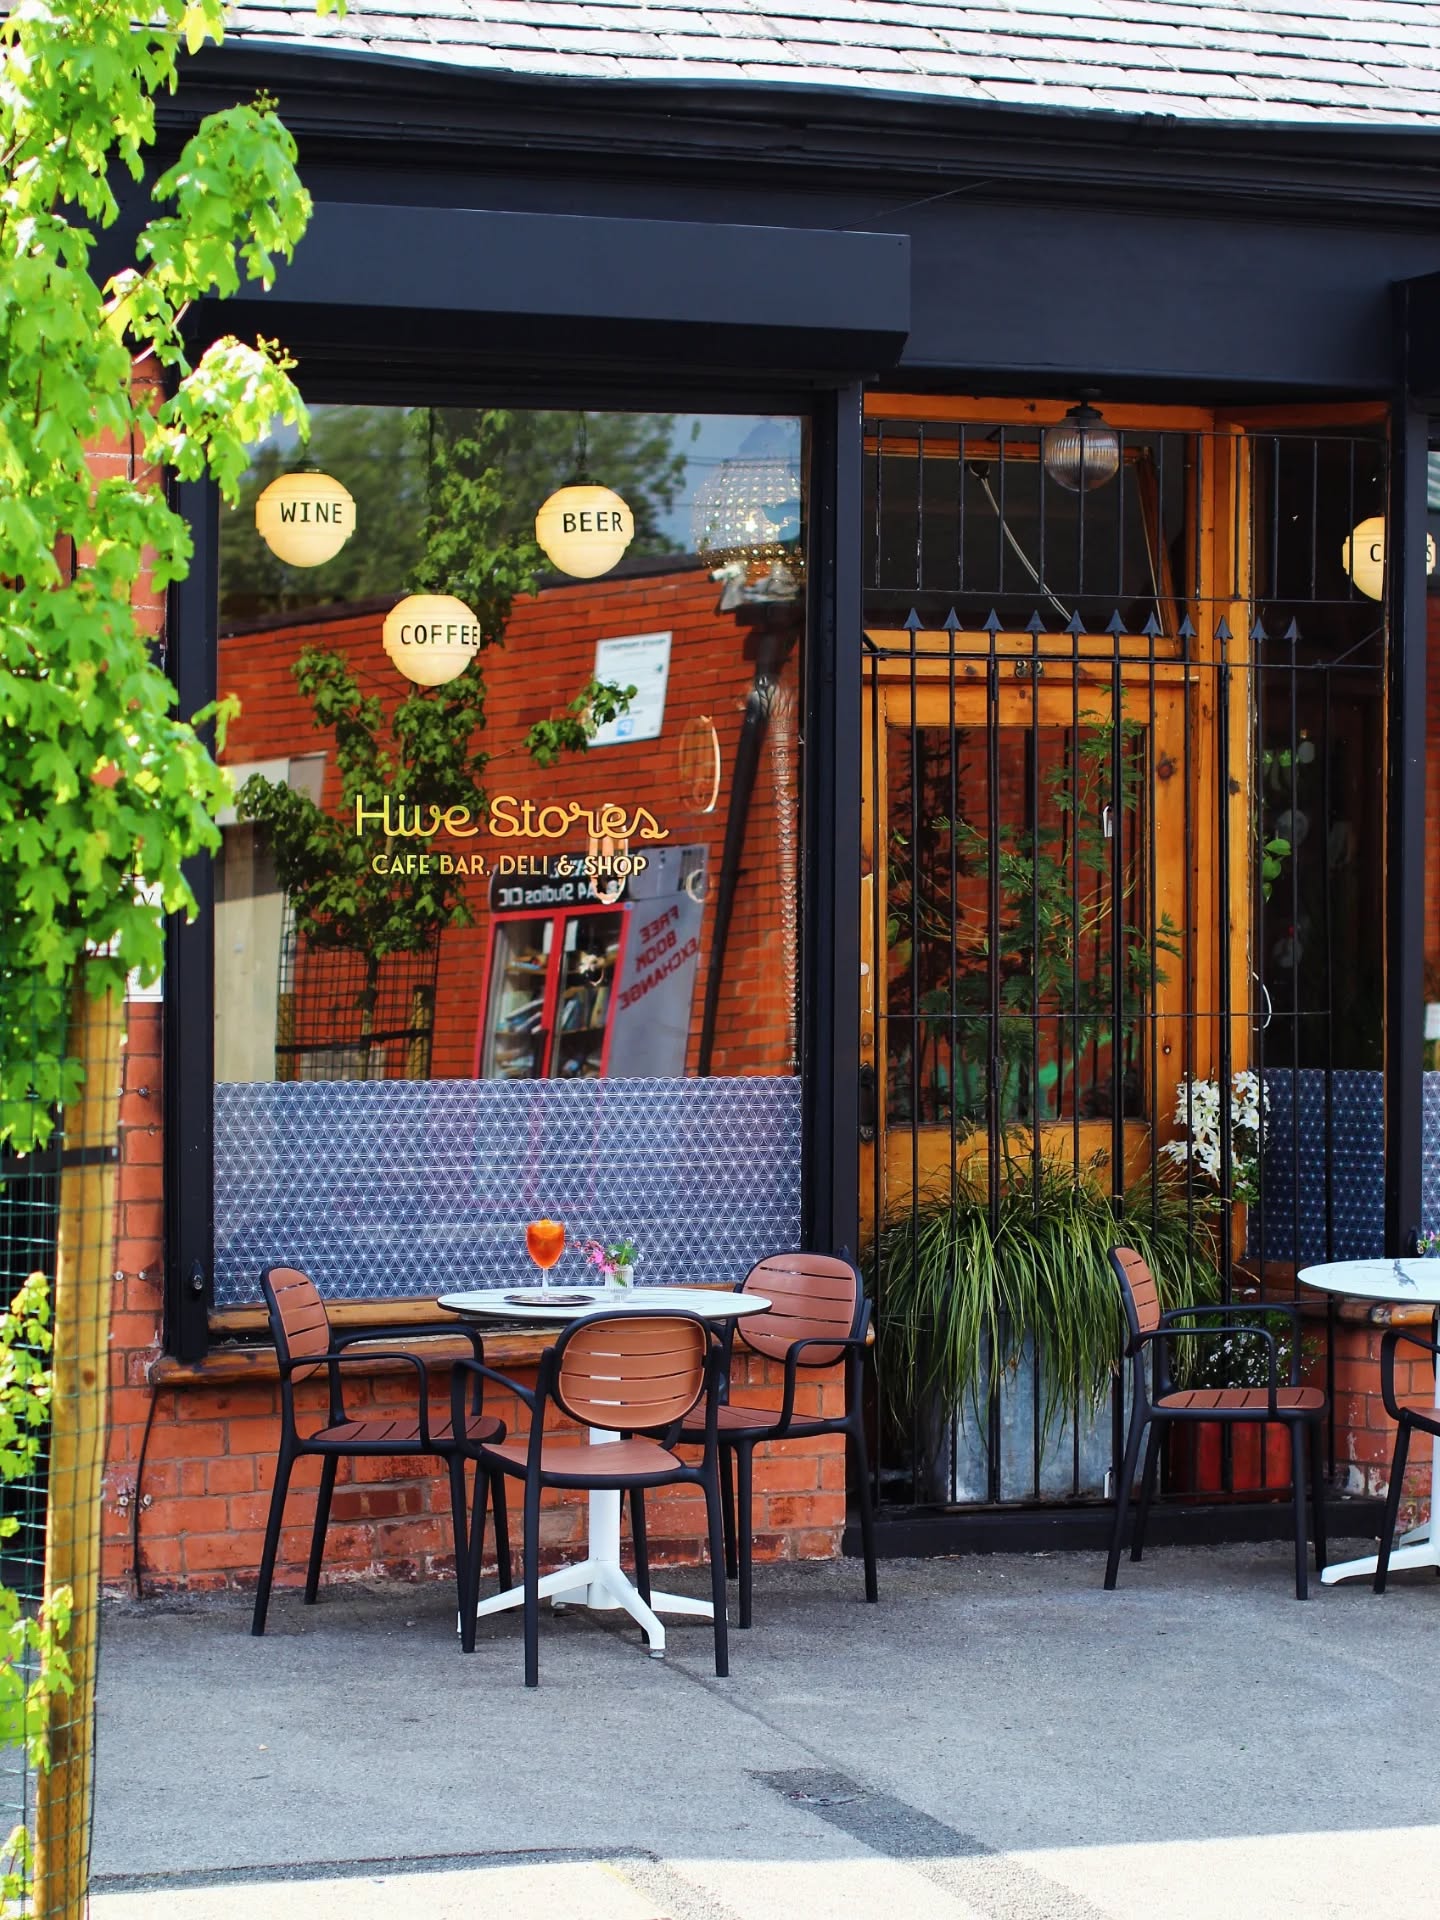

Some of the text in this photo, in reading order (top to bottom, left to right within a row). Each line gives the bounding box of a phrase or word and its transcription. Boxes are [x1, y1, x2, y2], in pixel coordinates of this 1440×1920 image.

[280, 502, 342, 524] WINE
[563, 511, 623, 533] BEER
[400, 624, 478, 646] COFFEE
[356, 793, 669, 839] Hive Stores
[371, 854, 430, 875] CAFE
[440, 854, 491, 876] BAR,
[499, 855, 548, 875] DELI
[557, 854, 575, 876] &
[584, 855, 647, 876] SHOP
